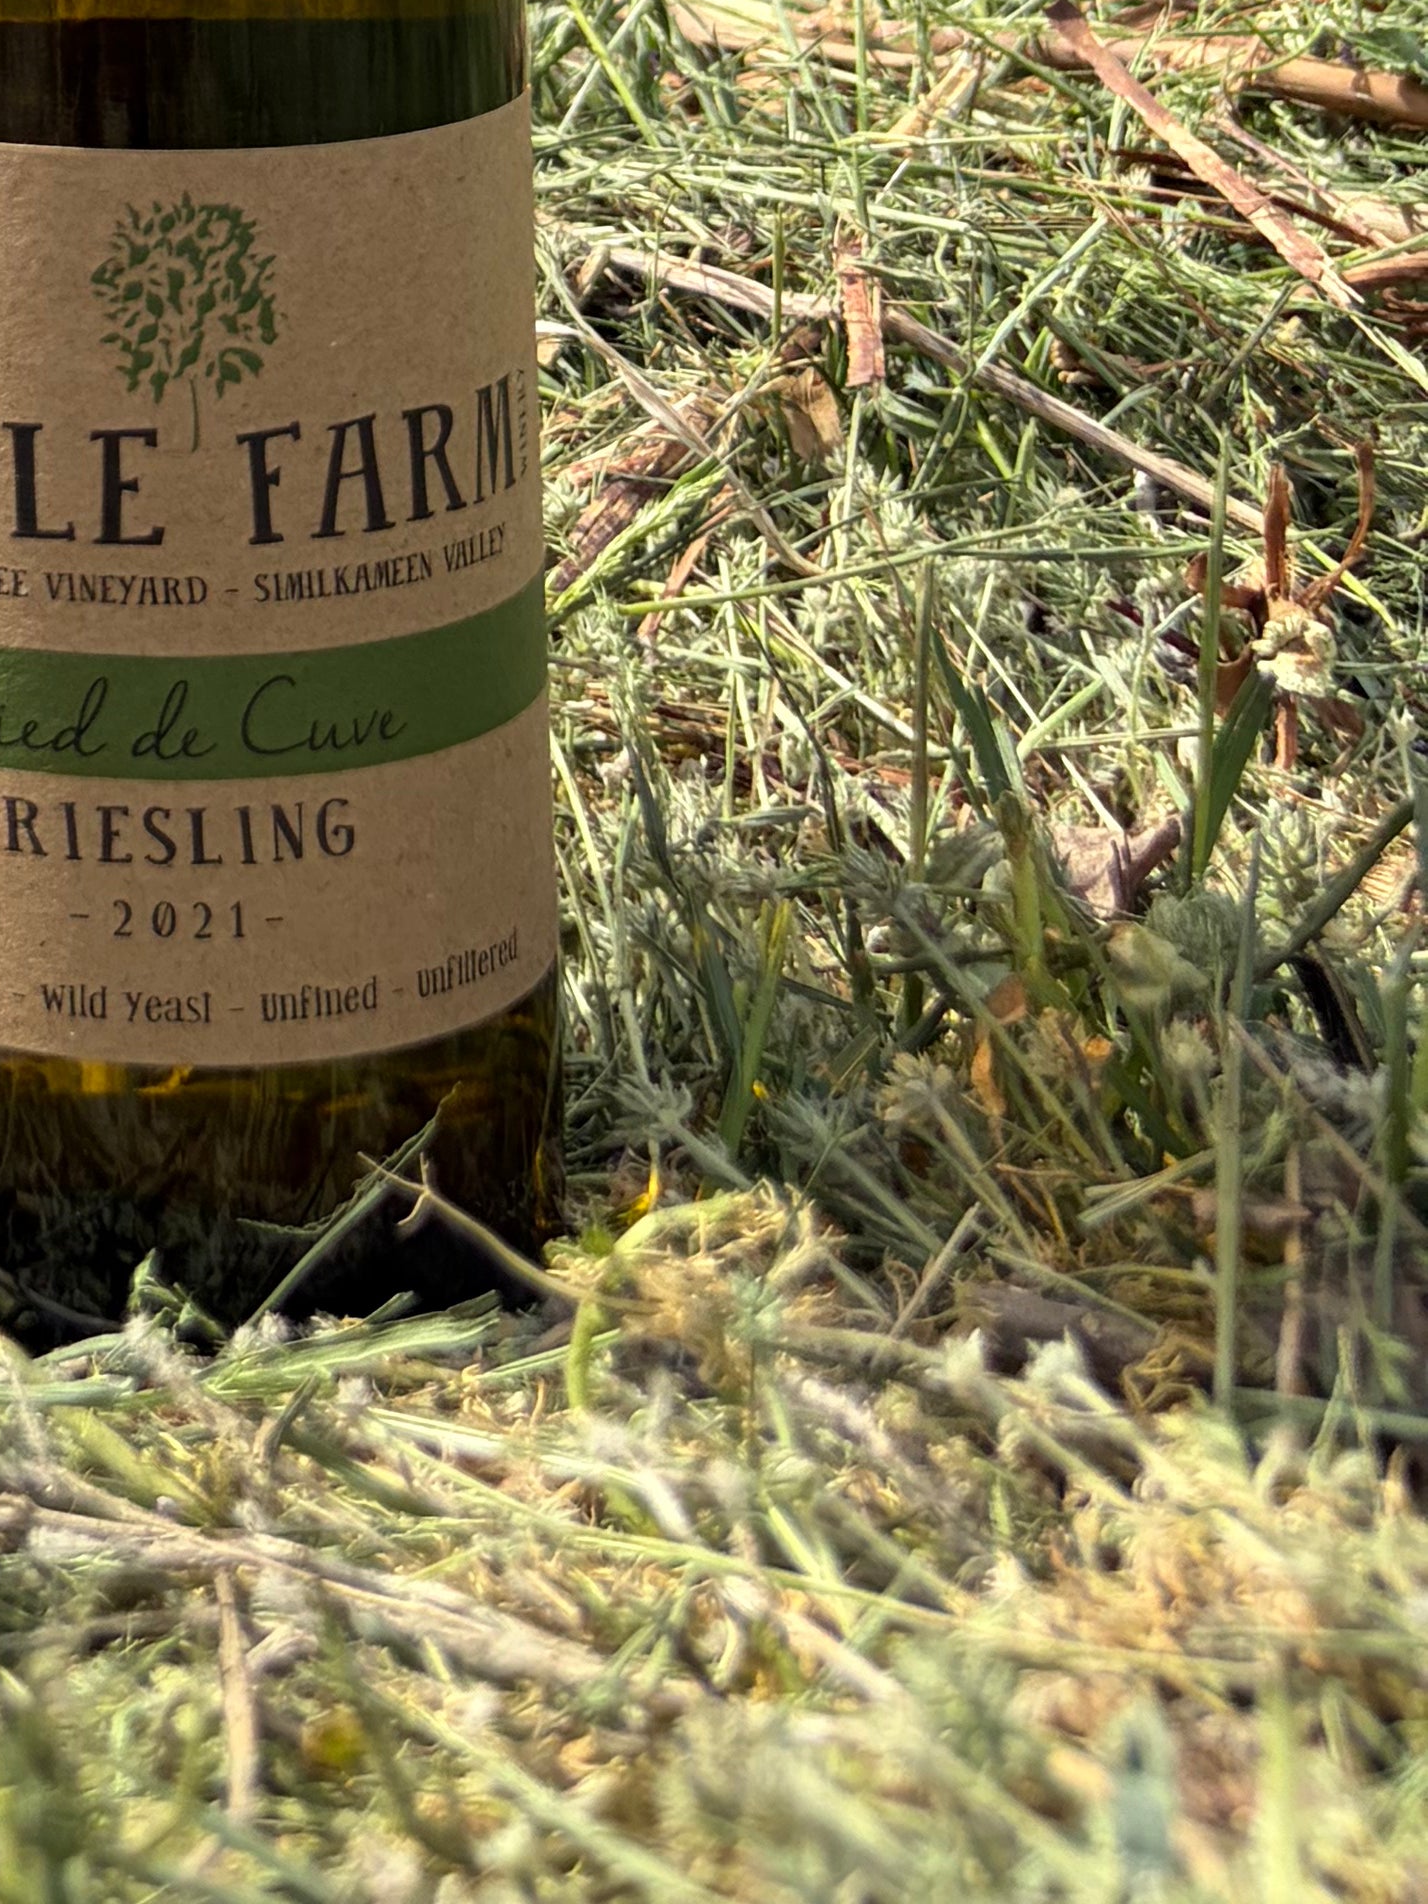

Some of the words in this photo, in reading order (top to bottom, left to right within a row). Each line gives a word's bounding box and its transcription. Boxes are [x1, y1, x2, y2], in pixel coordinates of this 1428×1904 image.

[235, 371, 517, 546] FARM
[45, 571, 208, 606] VINEYARD
[253, 552, 434, 603] SIMILKAMEEN
[443, 521, 507, 573] VALLEY
[131, 679, 218, 761] de
[240, 674, 408, 756] Cuve
[1, 795, 356, 866] RIESLING
[40, 983, 108, 1020] Wild
[124, 991, 212, 1024] Yeast
